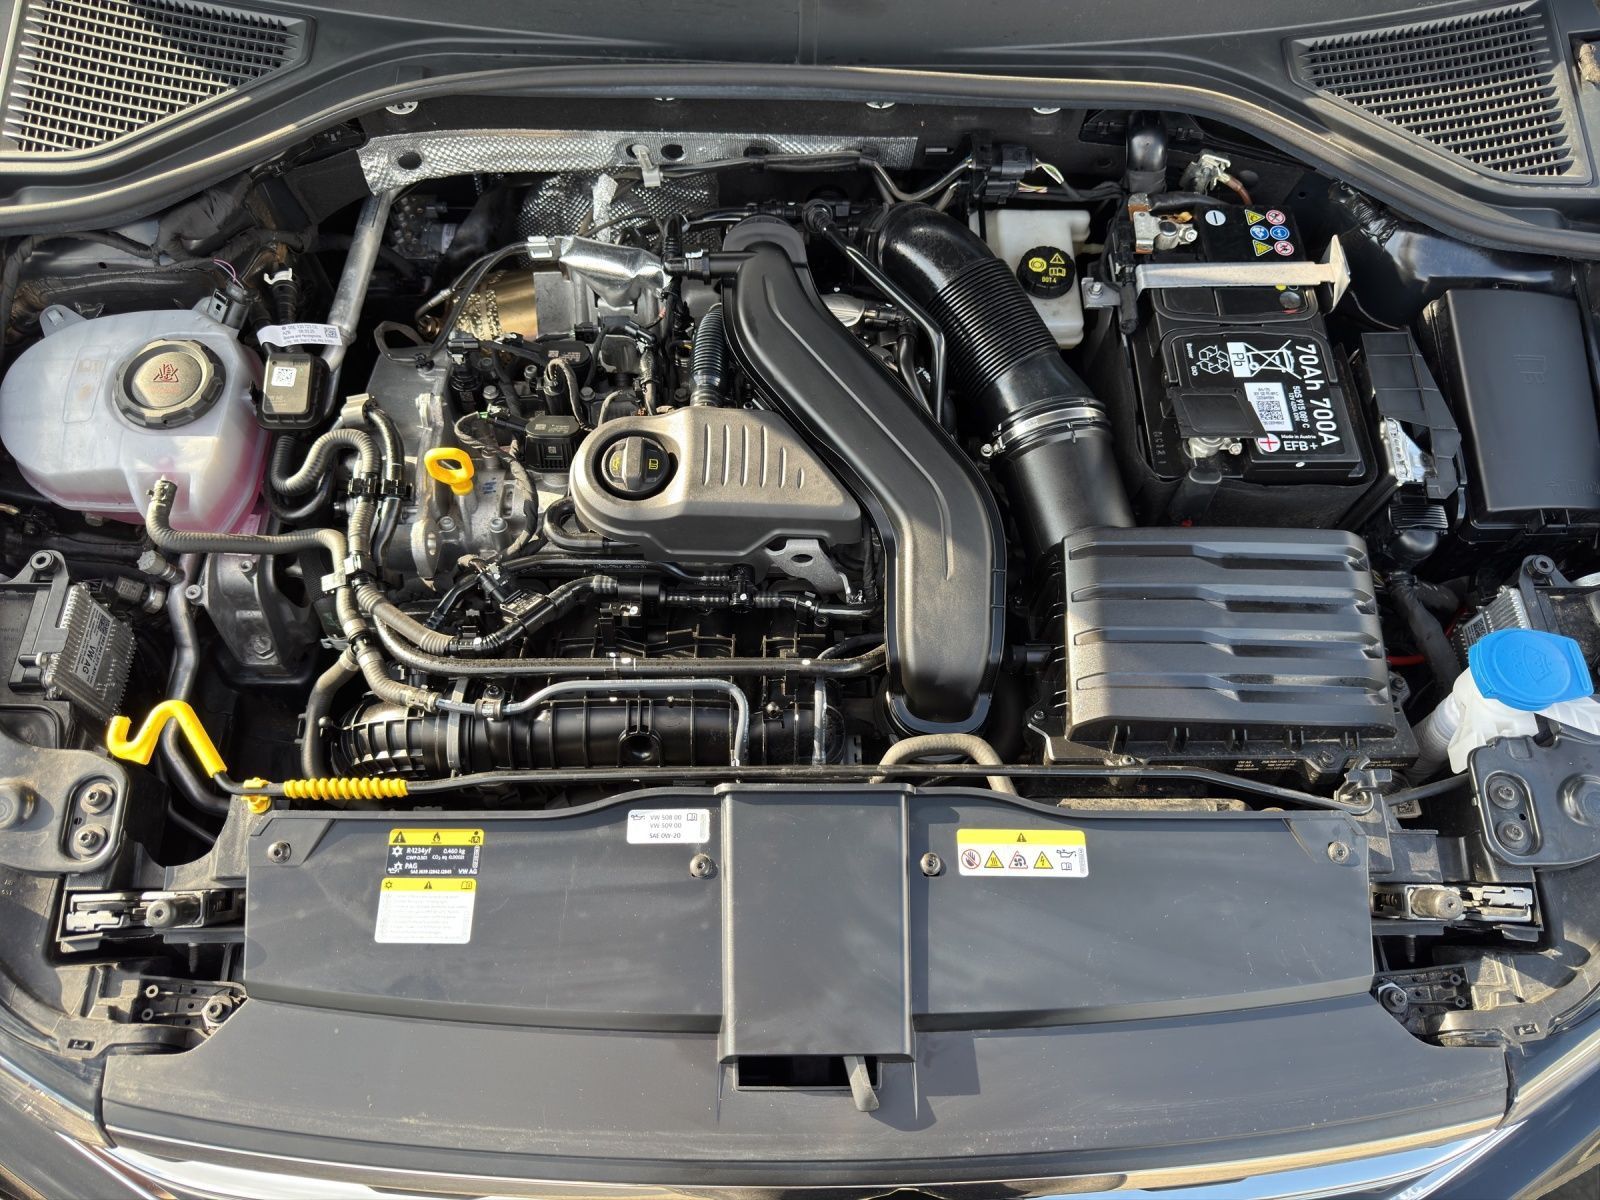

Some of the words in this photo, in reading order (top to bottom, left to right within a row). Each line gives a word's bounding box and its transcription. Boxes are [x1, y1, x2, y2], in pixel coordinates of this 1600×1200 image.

[1232, 352, 1246, 367] Pb
[1295, 344, 1325, 391] 70Ah
[1310, 398, 1341, 446] 700A
[1296, 398, 1307, 411] 915
[1283, 440, 1309, 451] EFB
[86, 644, 96, 658] VW
[82, 660, 91, 675] AG
